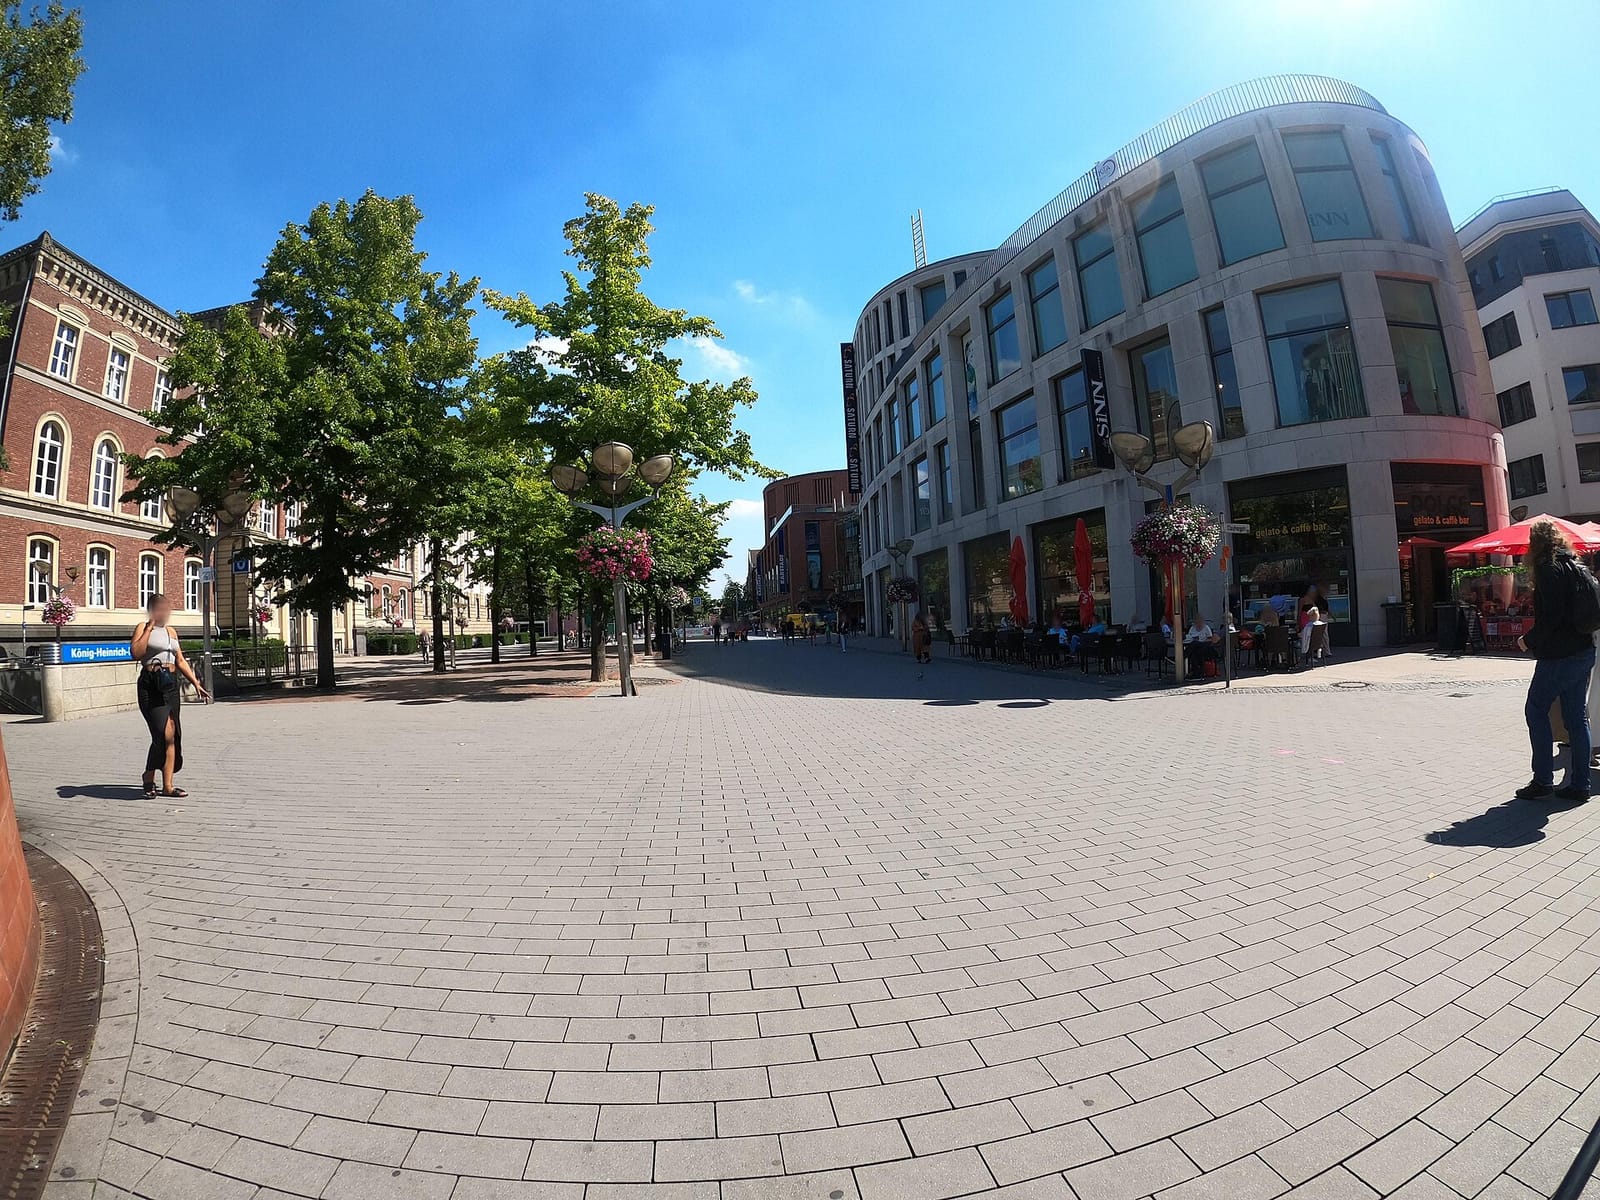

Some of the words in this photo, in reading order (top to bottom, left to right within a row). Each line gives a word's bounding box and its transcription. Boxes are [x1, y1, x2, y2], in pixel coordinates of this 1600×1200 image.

[844, 359, 854, 389] SATURN
[847, 407, 857, 438] SATURN
[850, 458, 859, 490] SATURN
[1255, 527, 1280, 539] gelato
[1282, 525, 1288, 534] &
[1312, 522, 1328, 531] bar
[1413, 515, 1434, 526] gelato
[1435, 515, 1441, 525] &
[1458, 515, 1470, 525] bar
